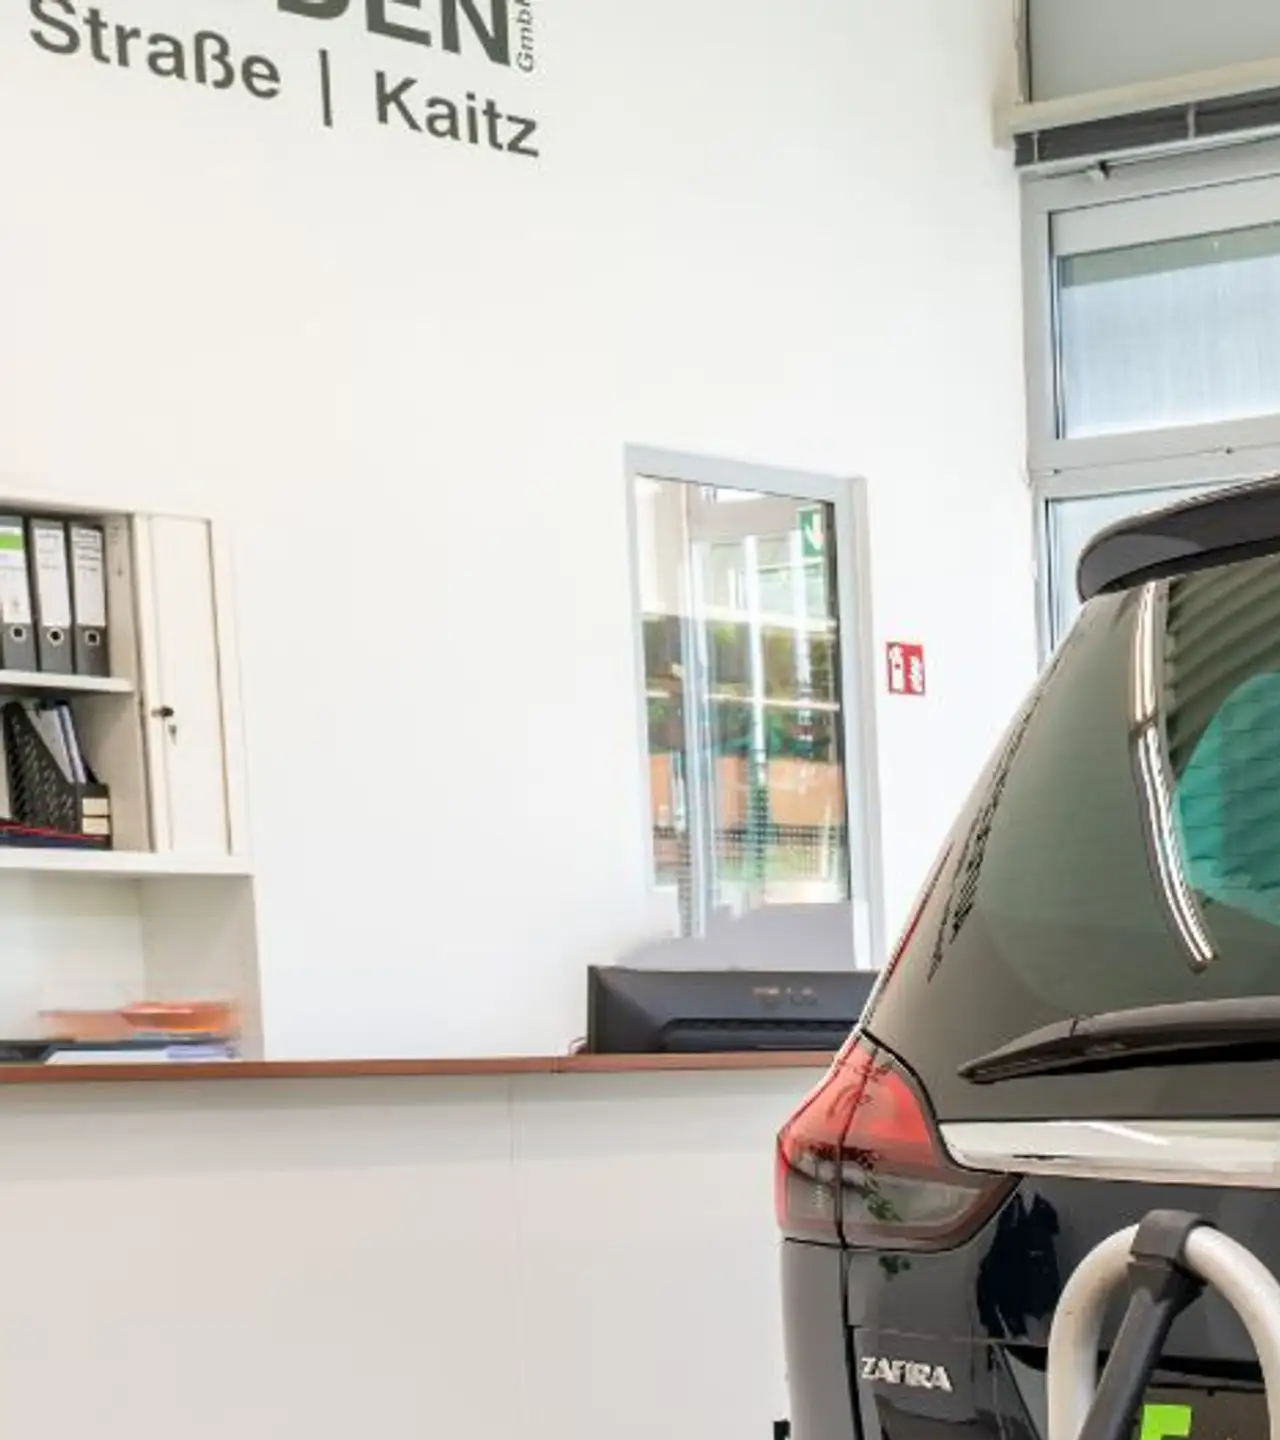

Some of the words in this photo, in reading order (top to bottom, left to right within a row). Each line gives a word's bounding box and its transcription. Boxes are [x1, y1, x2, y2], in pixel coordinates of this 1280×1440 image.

[277, 0, 511, 67] EN
[30, 0, 281, 99] Straße
[375, 70, 540, 158] Kaitz
[861, 1357, 954, 1392] ZAFIRA
